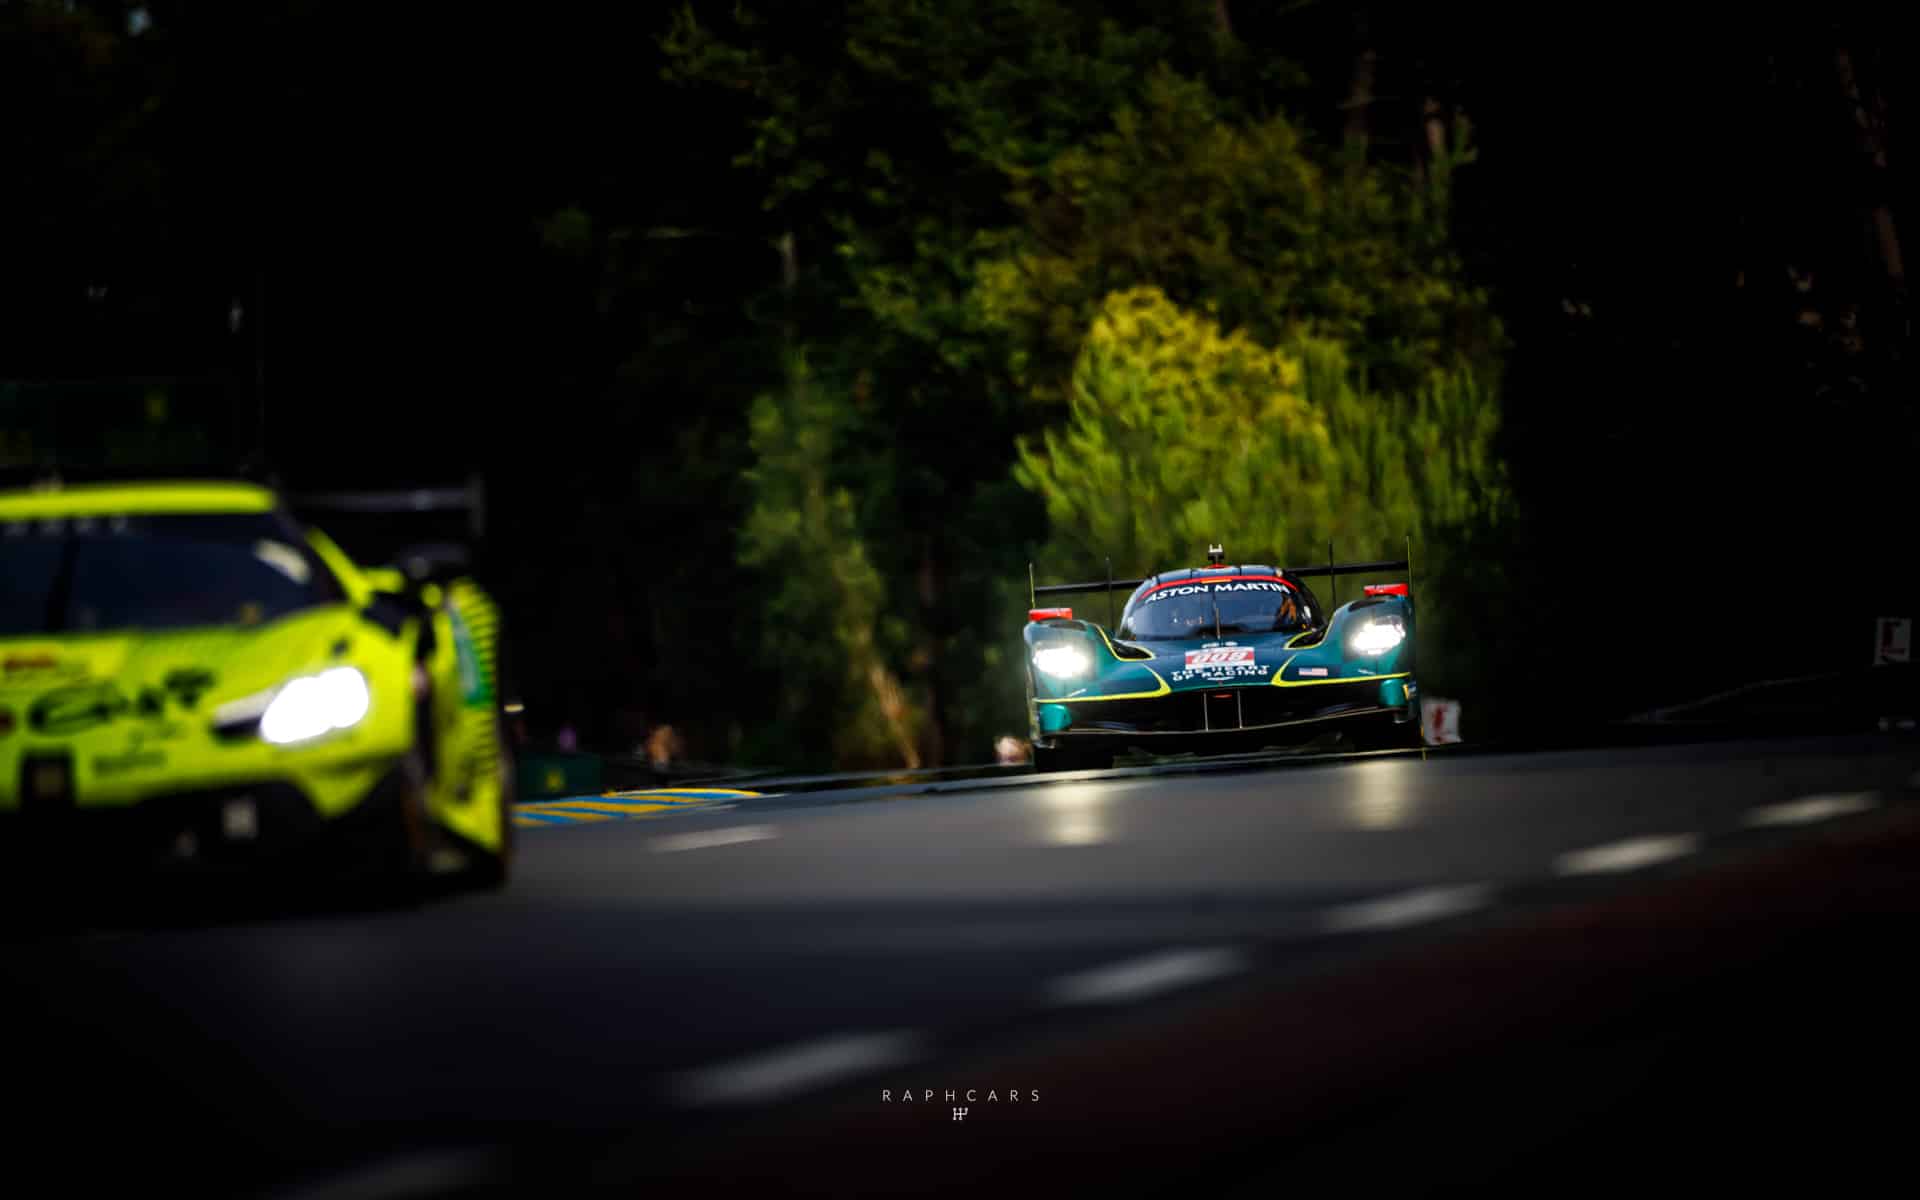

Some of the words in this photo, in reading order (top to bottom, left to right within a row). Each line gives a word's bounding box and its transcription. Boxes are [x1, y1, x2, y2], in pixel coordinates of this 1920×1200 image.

[1145, 585, 1208, 604] ASTON
[1215, 583, 1291, 594] MARTIN
[1171, 668, 1204, 676] THE
